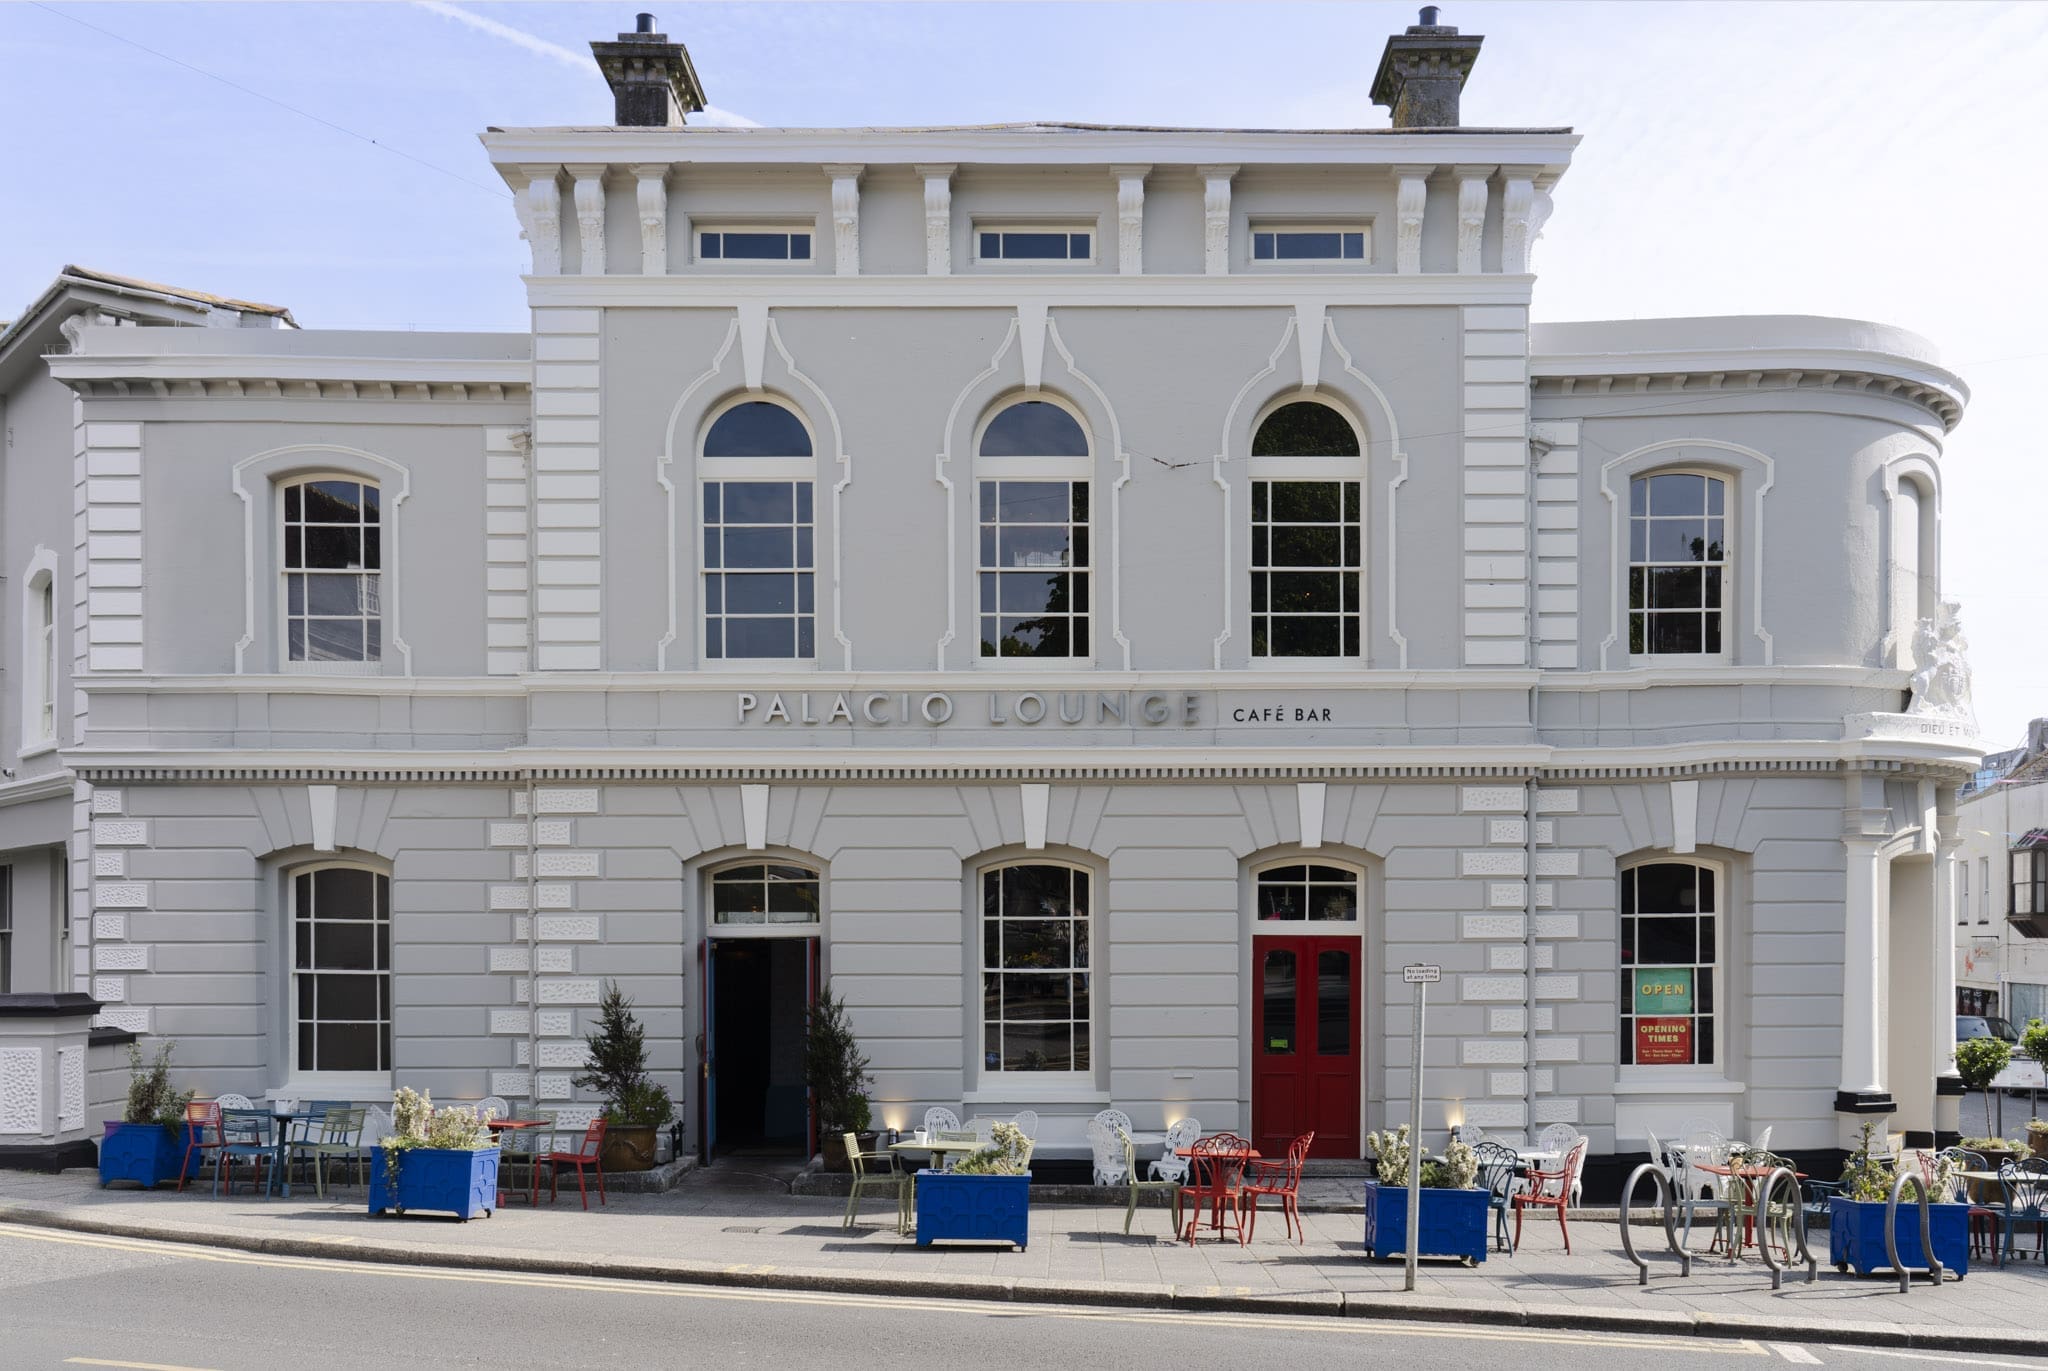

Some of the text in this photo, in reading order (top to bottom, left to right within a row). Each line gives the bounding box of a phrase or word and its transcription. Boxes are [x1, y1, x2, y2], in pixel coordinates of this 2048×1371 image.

[737, 692, 1201, 725] PALACIO LOUNGE
[1233, 704, 1331, 722] CAFÉ BAR
[1920, 723, 1944, 735] DIEU
[1949, 725, 1960, 736] ET
[1641, 984, 1685, 996] OPEN
[1640, 1025, 1686, 1034] OPENING
[1648, 1034, 1679, 1043] TIMES
